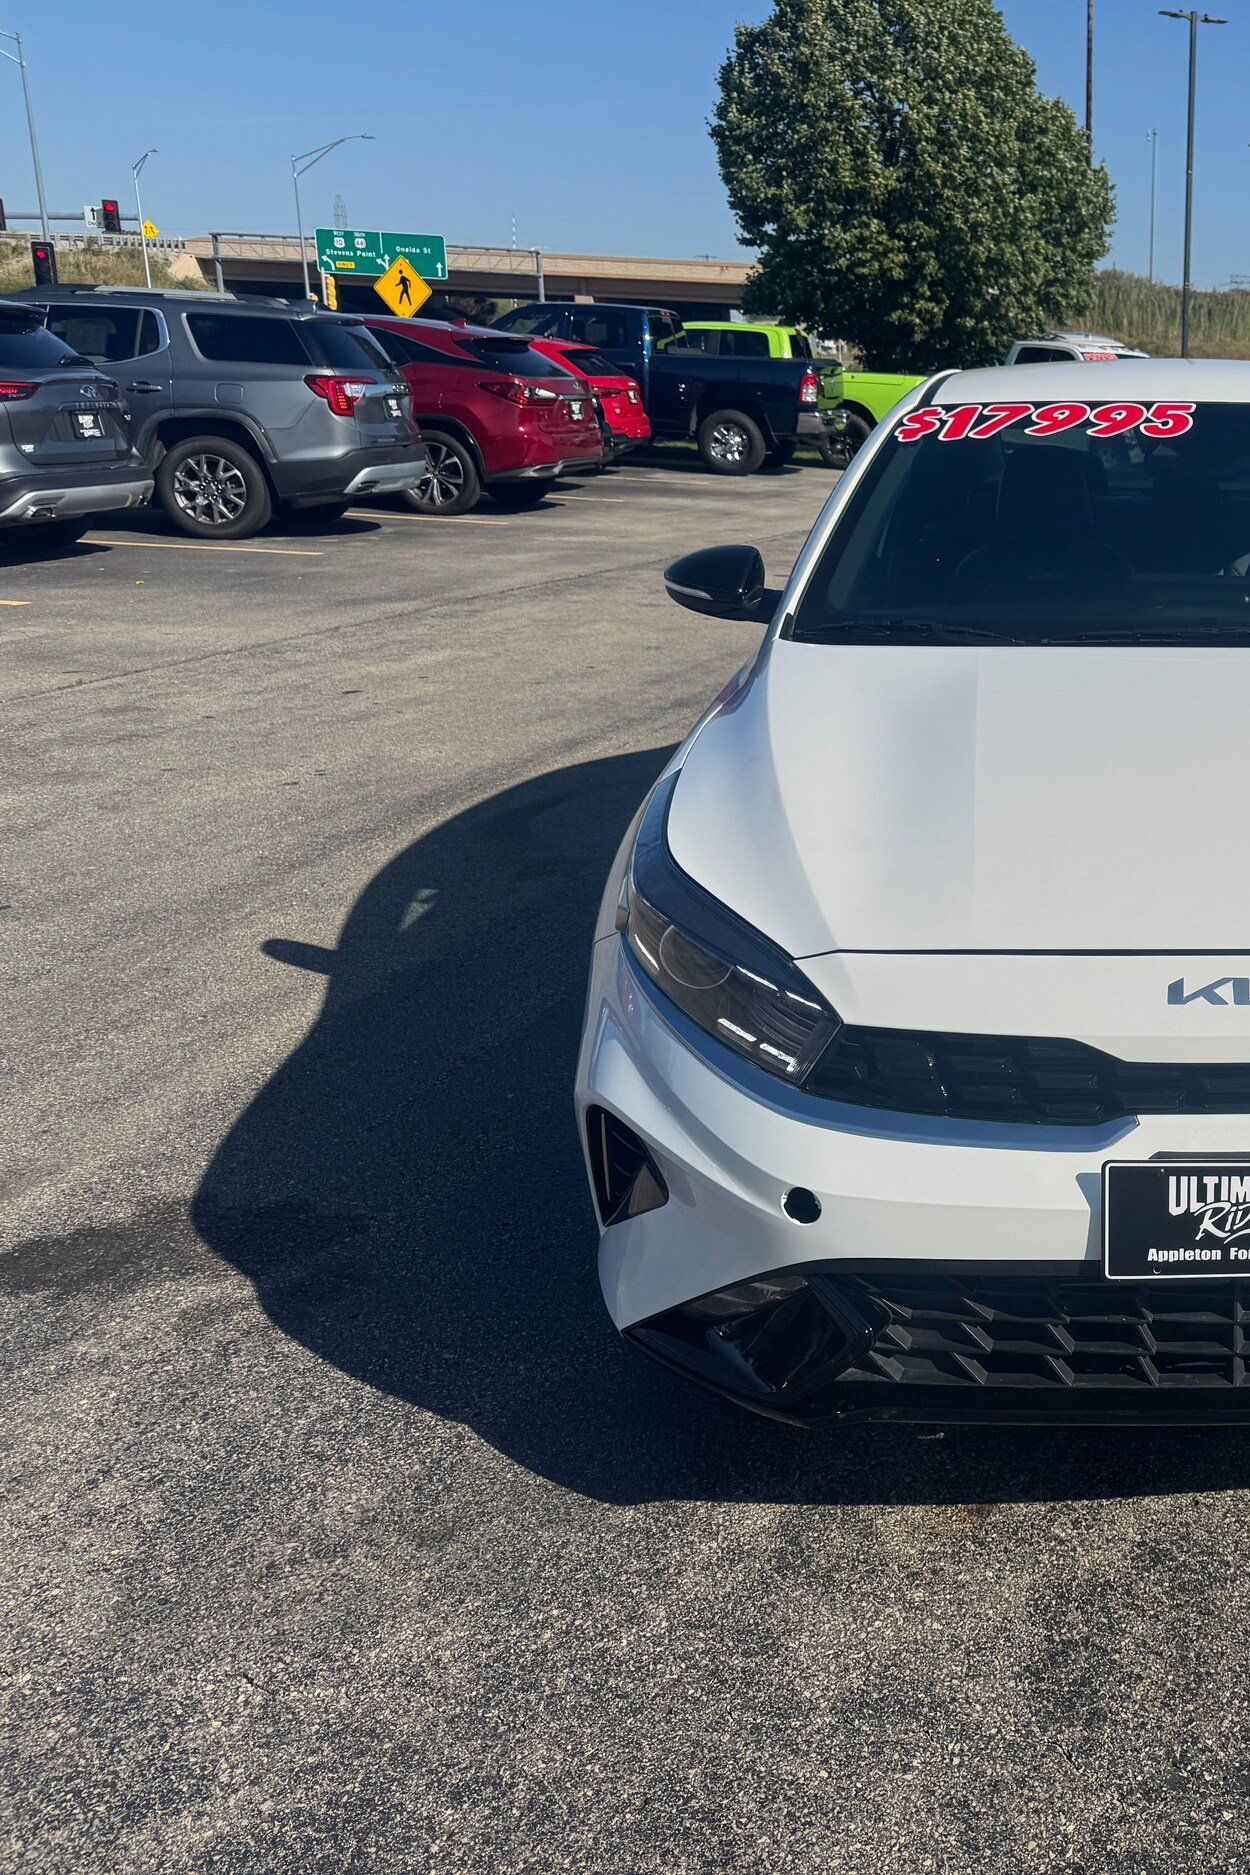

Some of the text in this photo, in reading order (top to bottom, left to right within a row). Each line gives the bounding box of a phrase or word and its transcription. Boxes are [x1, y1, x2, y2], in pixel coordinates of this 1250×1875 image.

[325, 248, 354, 256] Stevens
[895, 402, 1197, 442] $17995
[1147, 1248, 1222, 1262] Appleton
